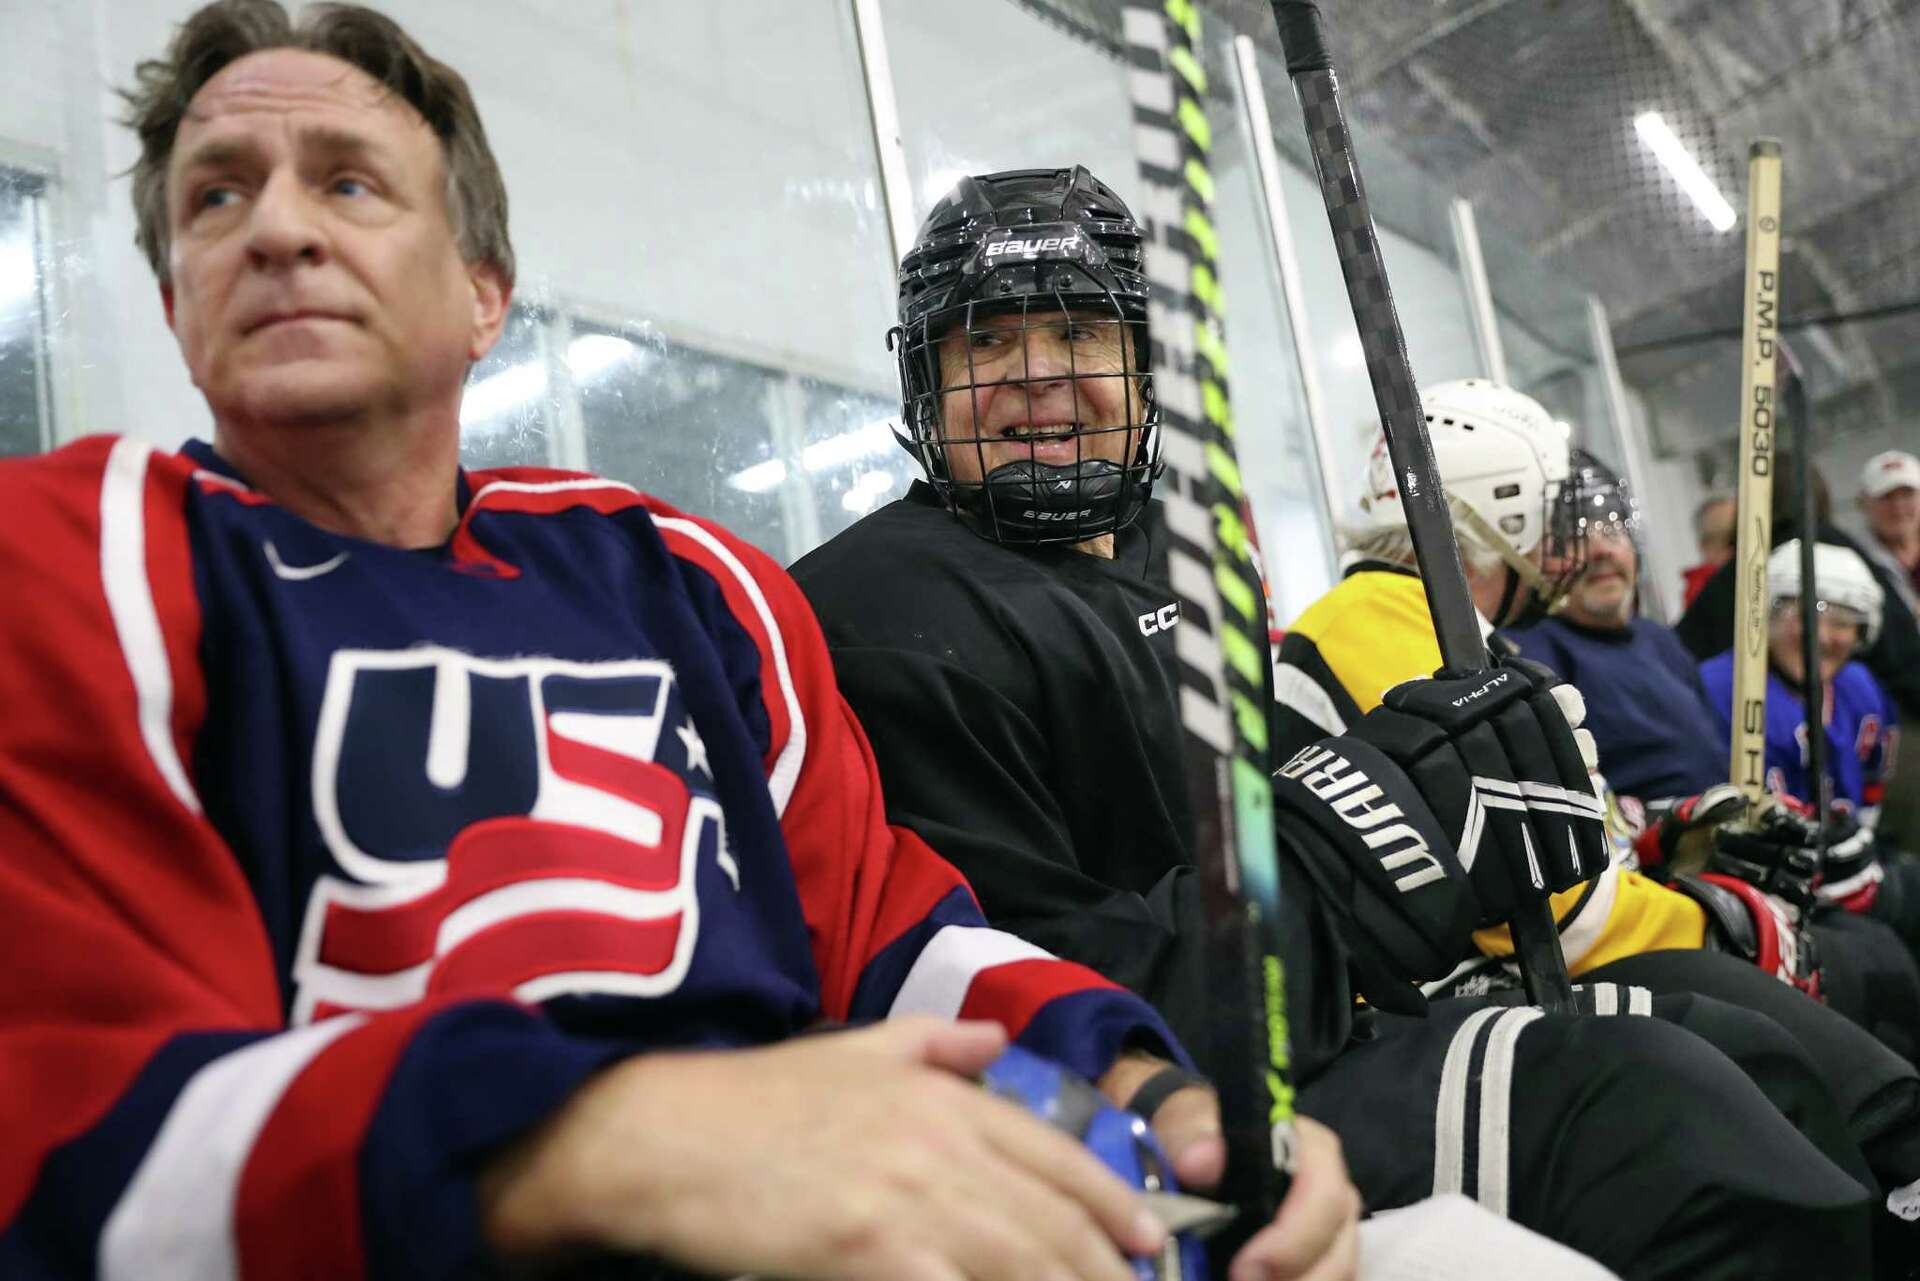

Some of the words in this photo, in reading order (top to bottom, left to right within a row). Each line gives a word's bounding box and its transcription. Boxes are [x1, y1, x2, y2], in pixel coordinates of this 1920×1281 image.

[985, 235, 1081, 256] BAUER
[1752, 385, 1773, 478] 5030
[1023, 509, 1092, 521] BAUER
[1138, 600, 1182, 637] CC
[1451, 673, 1508, 707] ALPHA
[1744, 698, 1763, 787] SH
[1272, 744, 1447, 893] WARR
